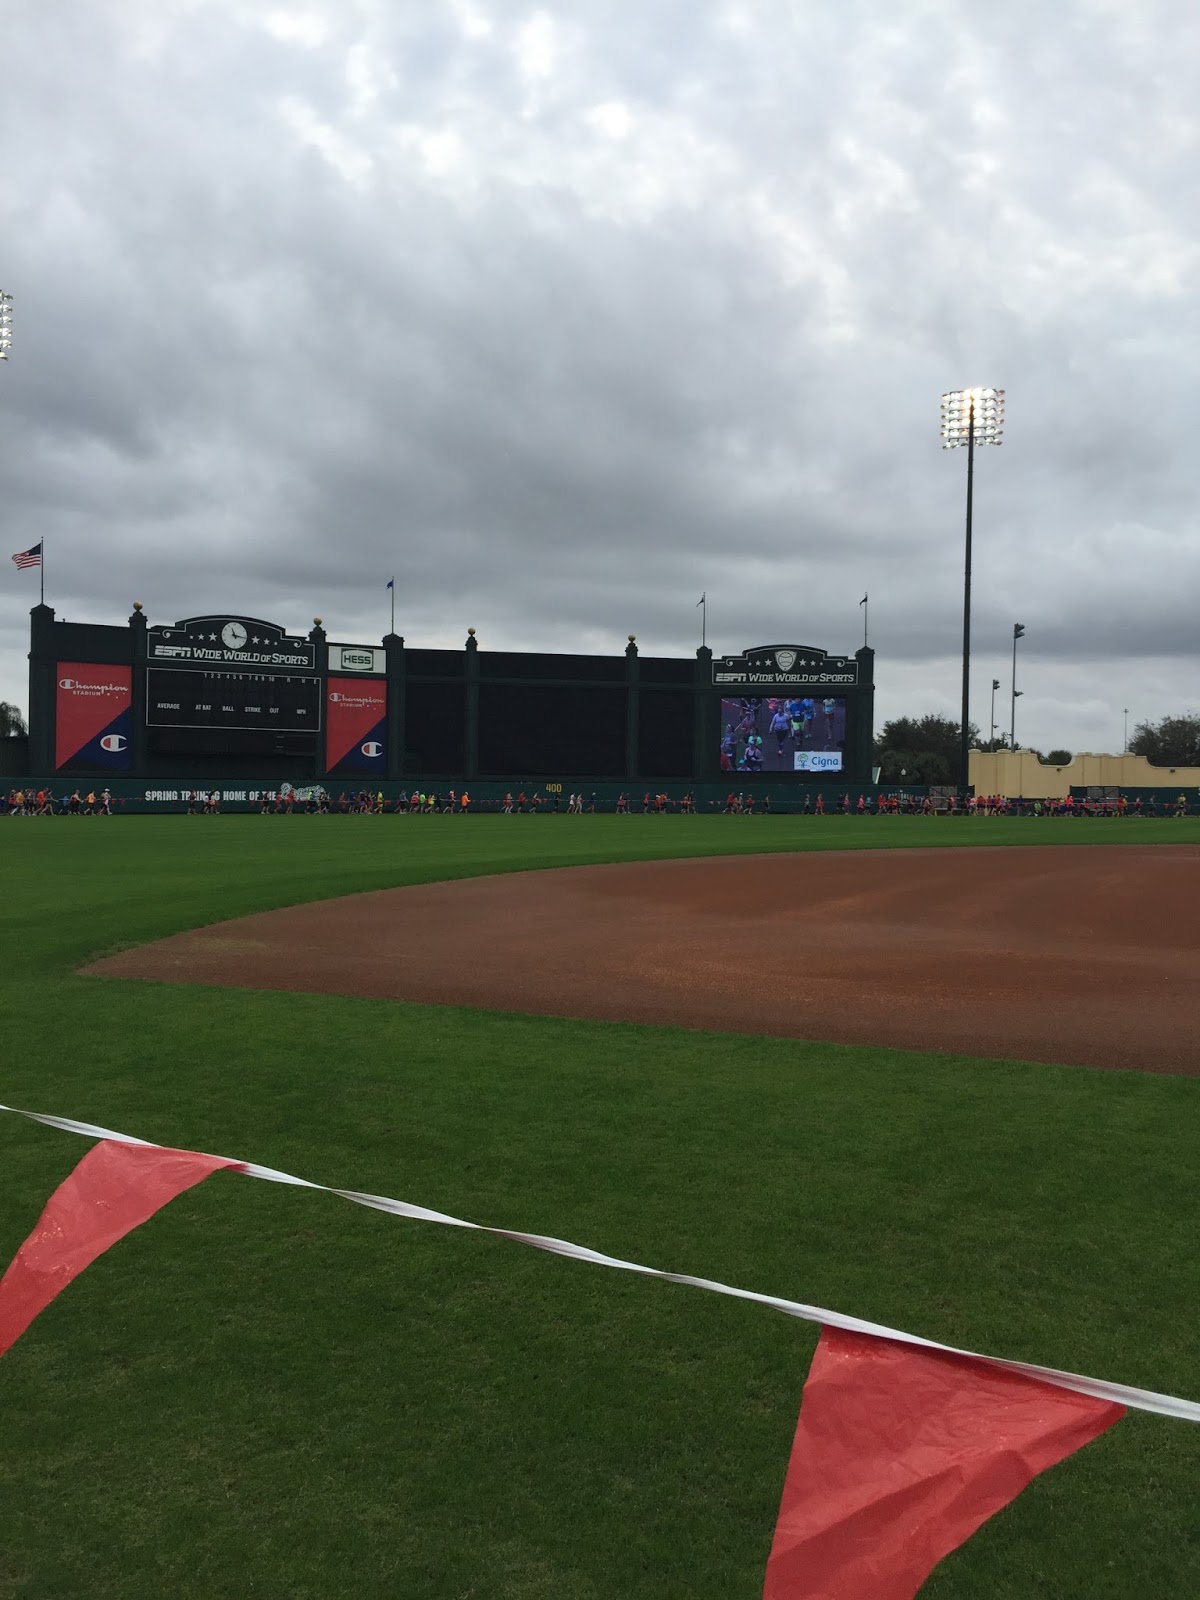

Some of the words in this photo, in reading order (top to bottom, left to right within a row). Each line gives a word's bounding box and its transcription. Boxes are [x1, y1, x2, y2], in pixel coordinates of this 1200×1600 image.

[155, 645, 191, 657] ESPN
[193, 648, 222, 659] WIDE
[223, 650, 260, 662] WORLD
[272, 653, 308, 664] SPORTS
[344, 655, 371, 664] HESS
[716, 673, 747, 682] ESPN
[748, 673, 774, 682] WIDE
[775, 673, 808, 682] WORLD
[820, 673, 854, 682] SPORTS
[59, 679, 128, 694] Champion
[329, 692, 384, 705] Champion
[811, 756, 839, 768] Cigna
[546, 784, 562, 793] 400
[145, 790, 178, 801] SPRING
[181, 791, 220, 801] TRING
[223, 791, 246, 801] HOME
[249, 791, 260, 801] OF
